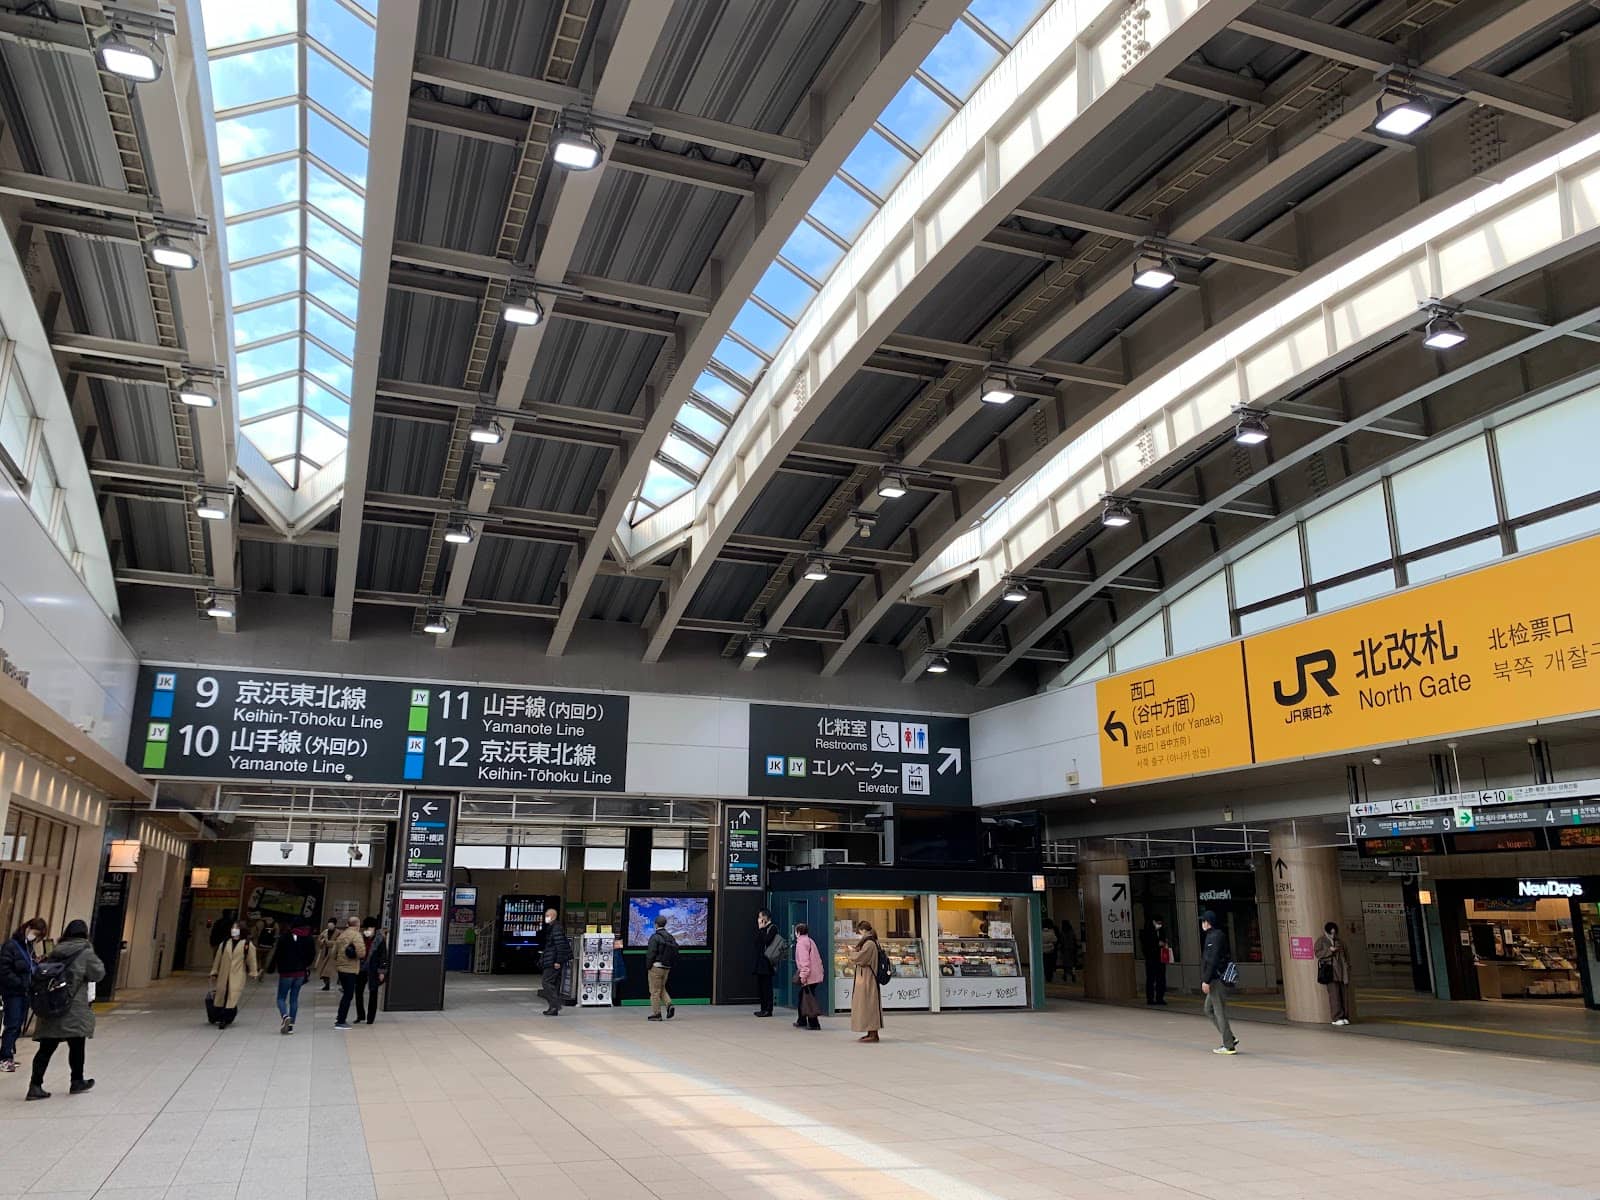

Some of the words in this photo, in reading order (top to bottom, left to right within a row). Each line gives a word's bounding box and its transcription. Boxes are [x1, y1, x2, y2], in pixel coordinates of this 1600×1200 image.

[1353, 619, 1459, 680] 北改札
[1273, 649, 1340, 707] JR
[1492, 658, 1534, 683] 북쪽
[158, 676, 173, 687] JK
[1130, 679, 1155, 702] 西口
[1359, 682, 1412, 711] North
[1419, 670, 1472, 699] Gate
[196, 677, 219, 708] 9
[235, 680, 367, 710] 京浜東北線
[414, 692, 427, 702] JY
[437, 690, 470, 720] 11
[483, 693, 605, 722] 山手線（内回り）
[1132, 692, 1196, 726] （谷中方面）
[1285, 703, 1333, 724] JR東日本
[234, 708, 346, 727] Keihin-Tōhoku
[351, 714, 383, 729] Line
[482, 719, 552, 736] Yamanote
[556, 723, 585, 737] Line
[817, 717, 868, 738] 化粧室
[1134, 727, 1154, 741] West
[1155, 724, 1171, 738] Exit
[1172, 720, 1186, 736] (for
[1188, 712, 1224, 730] Yanaka)
[151, 726, 166, 737] JY
[178, 724, 219, 757] 10
[230, 728, 368, 757] 山手線（外回り）
[409, 739, 422, 750] JK
[434, 736, 470, 767] 12
[815, 738, 868, 752] Restrooms
[479, 739, 597, 767] 京浜東北線
[229, 755, 308, 773] Yamanote
[313, 759, 345, 774] Line
[769, 760, 781, 771] JK
[791, 761, 803, 772] JY
[811, 759, 899, 779] エレベーター
[478, 766, 579, 784] Keihin-Tōhoku
[583, 770, 612, 785] Line
[858, 781, 900, 794] Elevator
[1494, 790, 1506, 803] 10
[1403, 797, 1414, 810] 11
[411, 812, 420, 822] 9
[729, 820, 739, 829] 11
[1443, 817, 1451, 830] 9
[1545, 810, 1555, 824] 4
[1355, 824, 1367, 837] 12
[408, 848, 421, 858] 10
[729, 853, 740, 863] 12
[1518, 880, 1583, 897] NewDays
